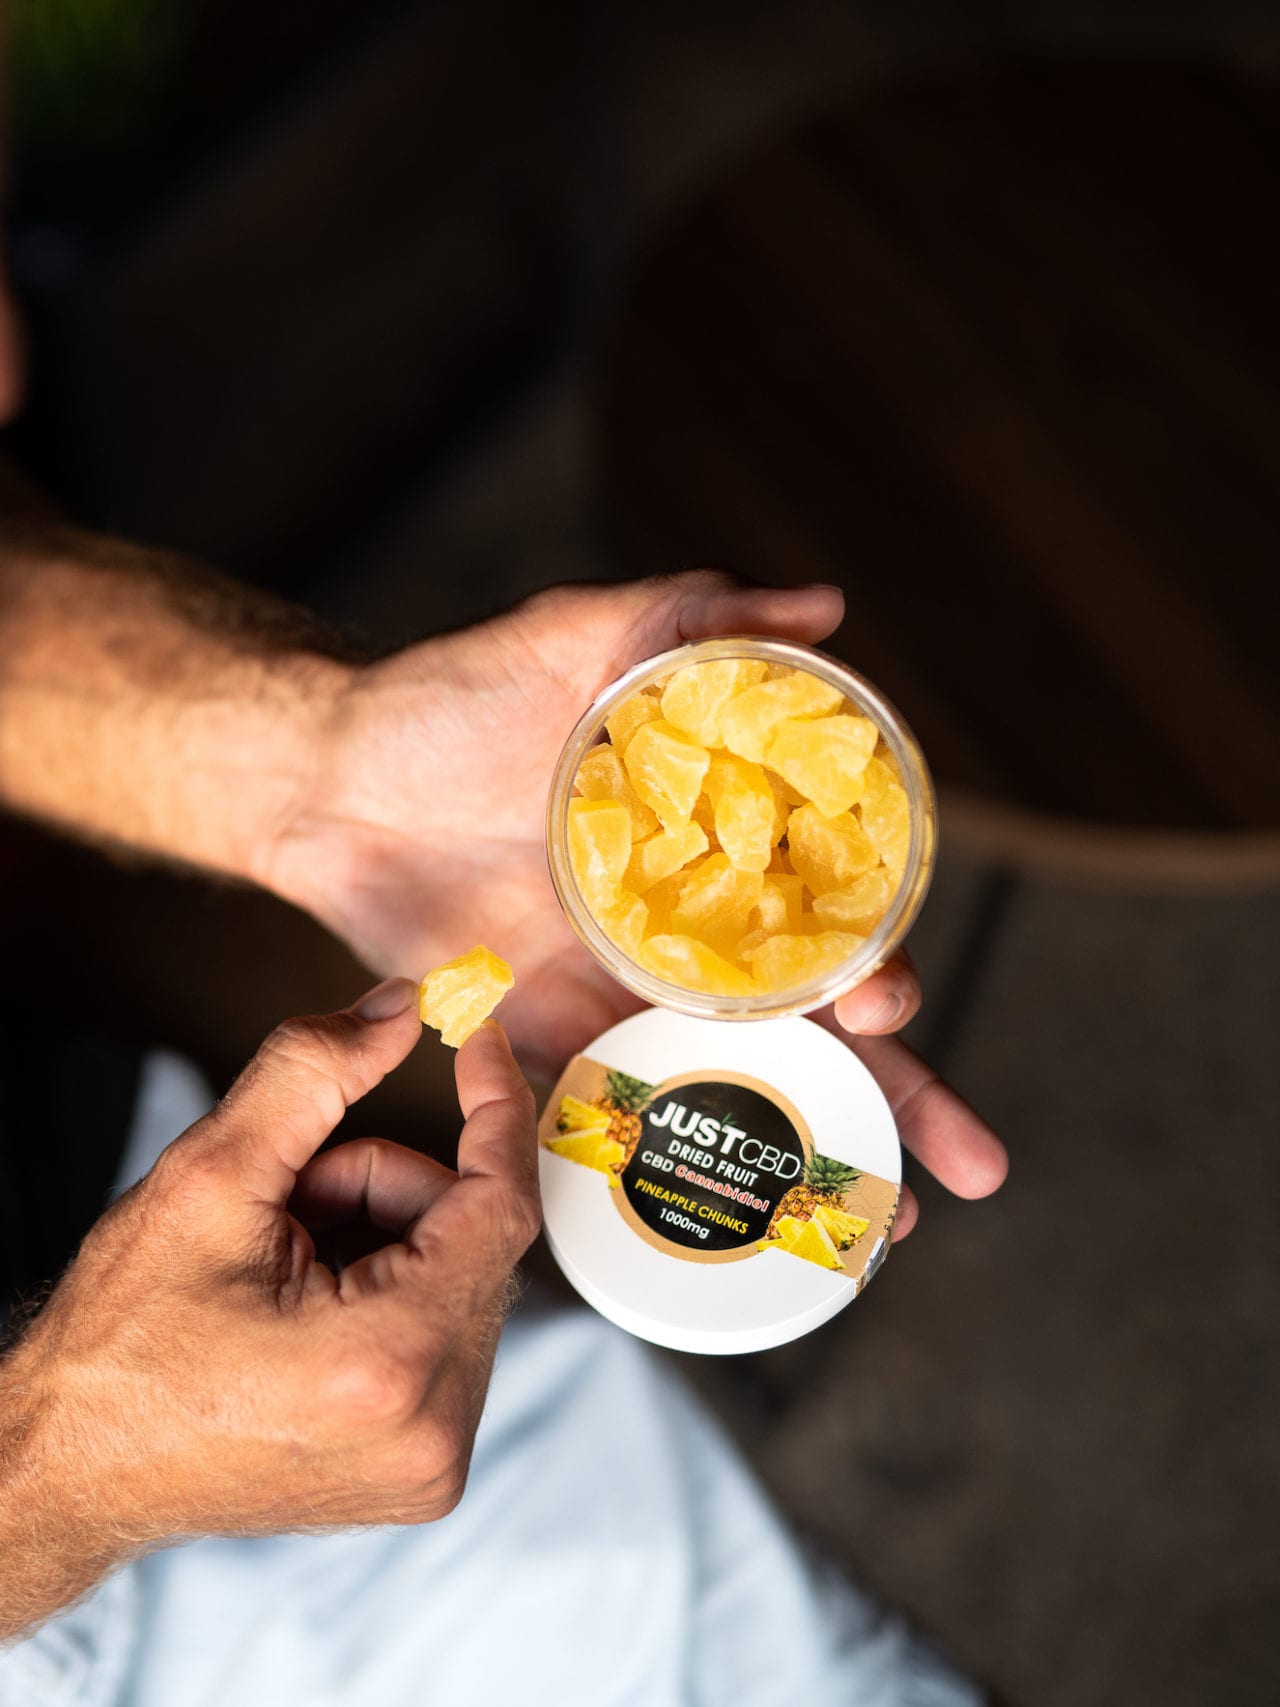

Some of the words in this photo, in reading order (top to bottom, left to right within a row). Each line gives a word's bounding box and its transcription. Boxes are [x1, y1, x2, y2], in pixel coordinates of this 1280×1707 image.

[641, 1150, 674, 1172] CBD
[675, 1165, 770, 1212] Cannabidiol
[667, 1139, 714, 1169] DRIED
[716, 1160, 759, 1187] FRUIT
[635, 1177, 697, 1213] PINEAPPLE
[698, 1205, 749, 1235] CHUNKS
[660, 1208, 710, 1240] 1000mg
